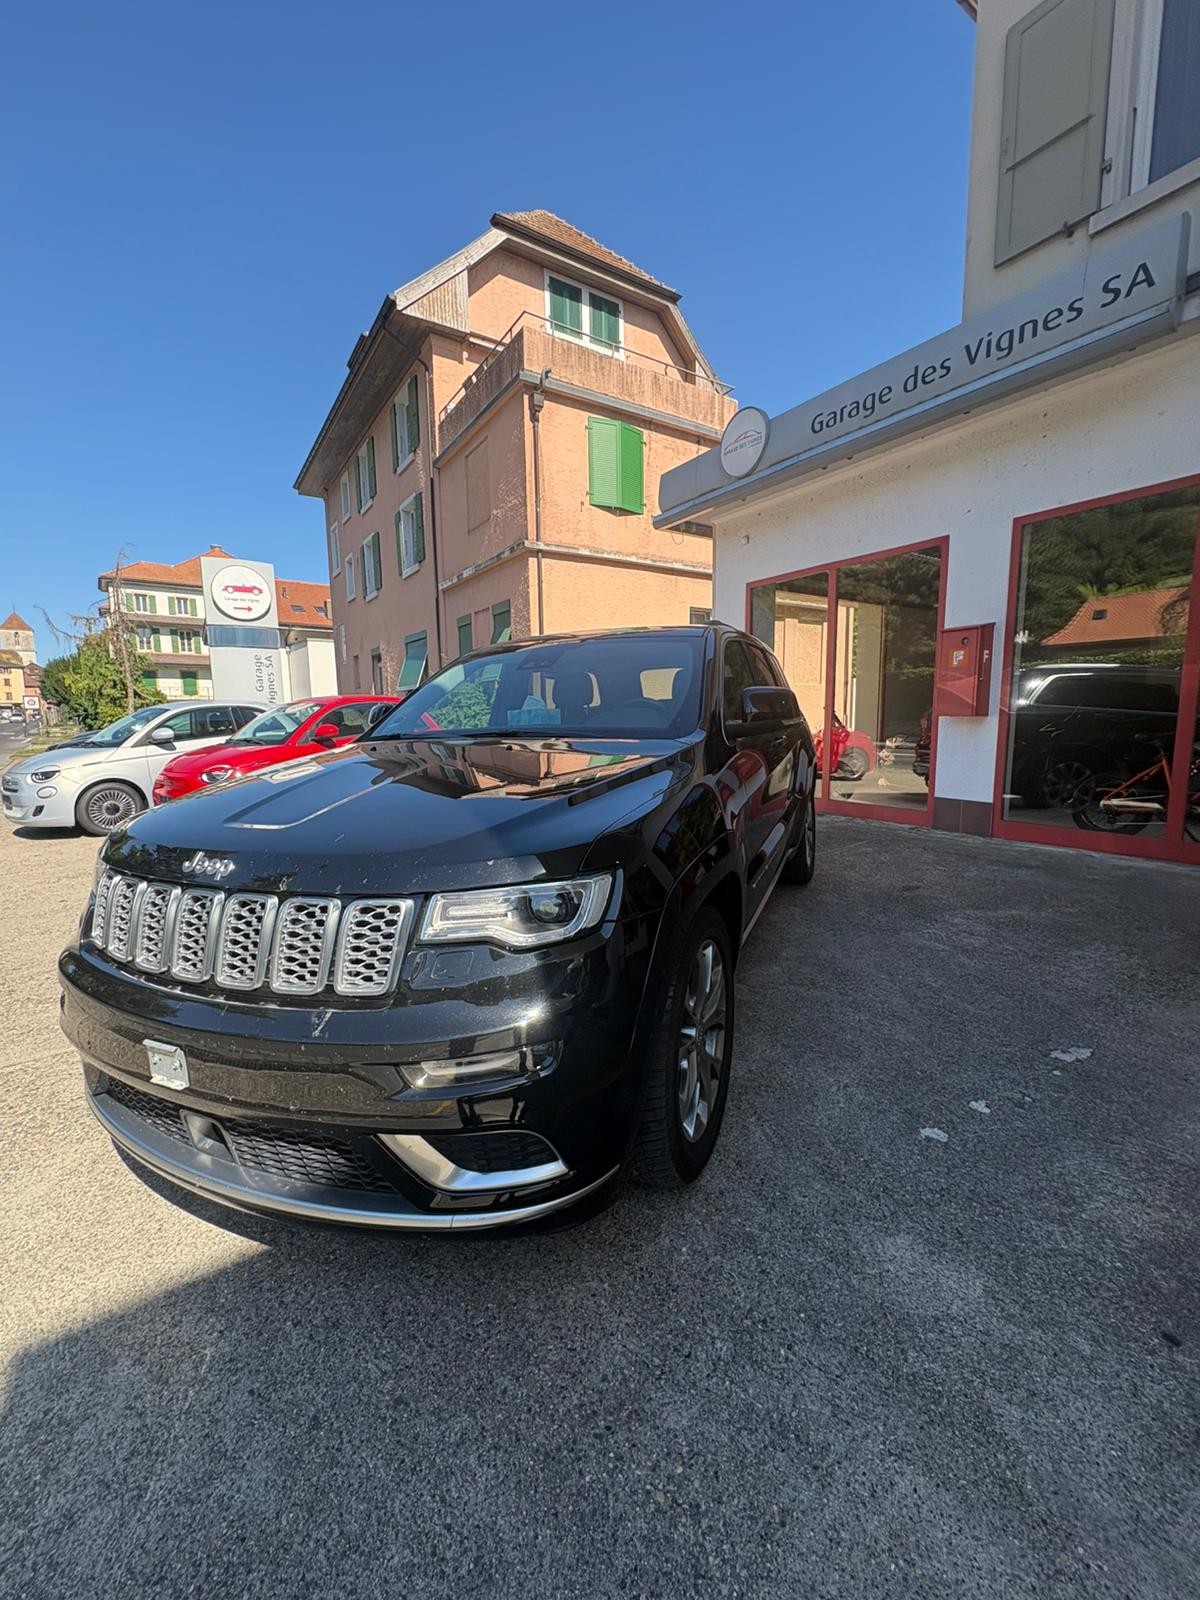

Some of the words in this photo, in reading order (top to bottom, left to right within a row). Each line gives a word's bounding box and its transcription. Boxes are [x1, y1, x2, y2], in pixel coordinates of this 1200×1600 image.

[811, 385, 893, 434] Garage
[903, 357, 952, 393] des
[964, 297, 1084, 365] Vignes
[1100, 262, 1157, 308] SA
[264, 655, 274, 669] SA
[983, 649, 989, 663] F
[254, 654, 265, 692] Garage
[182, 850, 236, 881] Jeep
